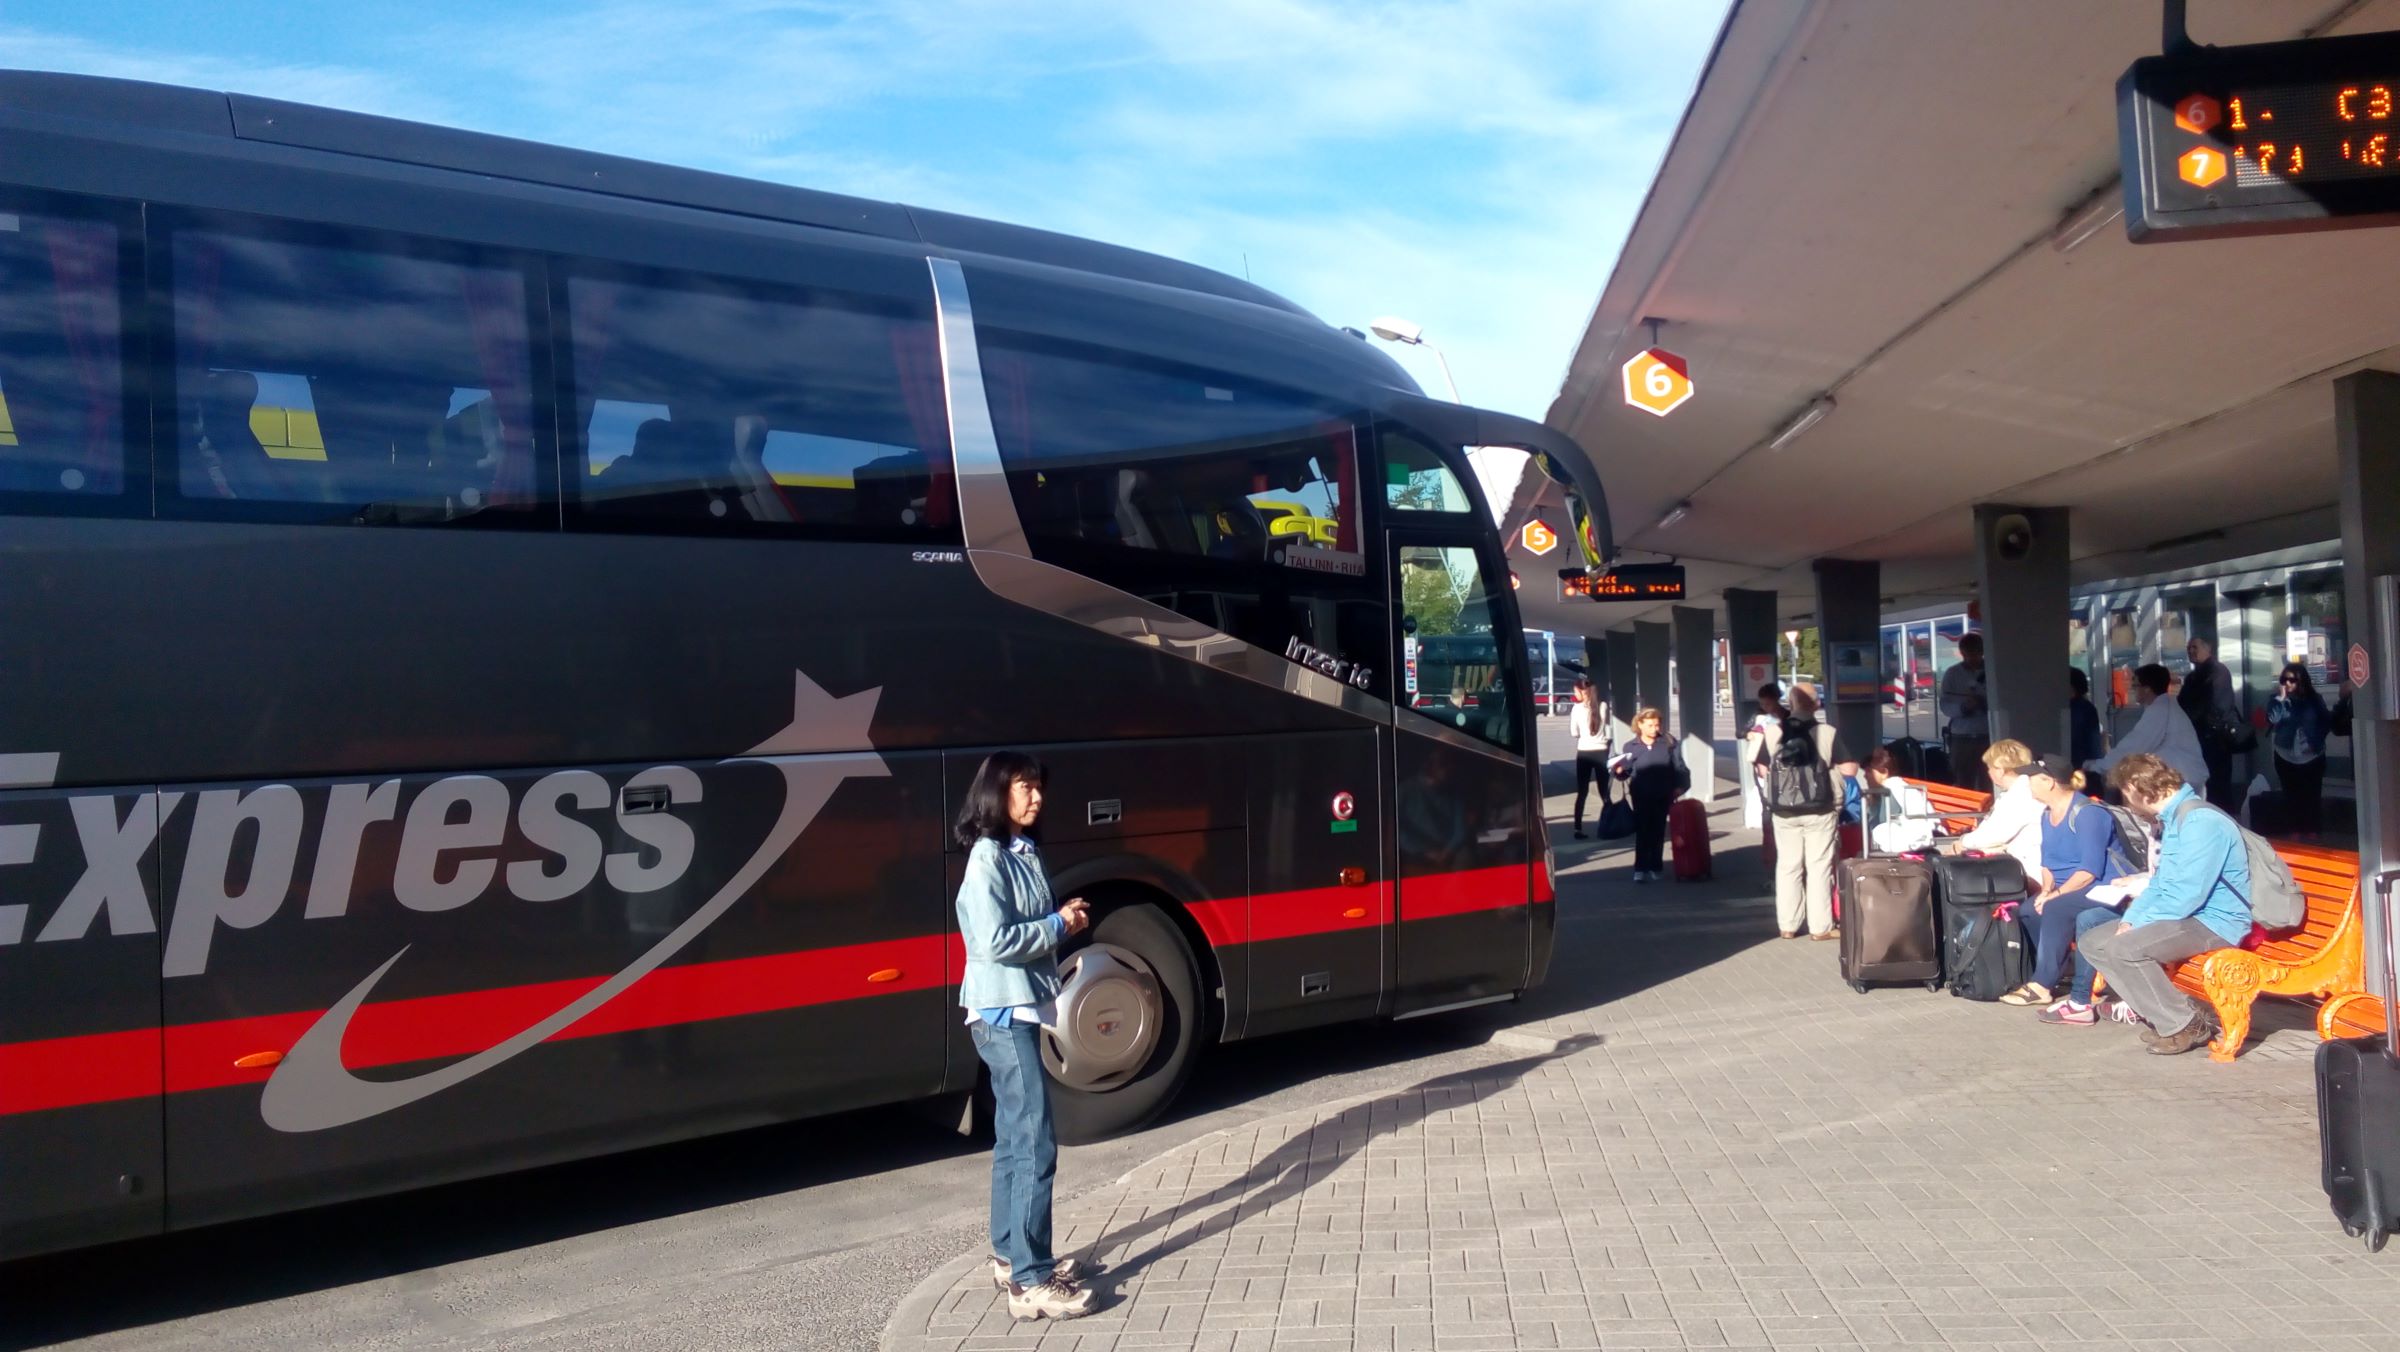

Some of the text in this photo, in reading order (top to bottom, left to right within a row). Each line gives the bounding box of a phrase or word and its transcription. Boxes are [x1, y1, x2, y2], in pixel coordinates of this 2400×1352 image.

[2188, 101, 2206, 125] 6
[2191, 153, 2209, 179] 7
[1644, 362, 1673, 398] 6
[1533, 527, 1547, 546] 5
[912, 551, 963, 562] SCANIA
[1289, 555, 1333, 571] TALLINN
[1348, 662, 1373, 690] i6
